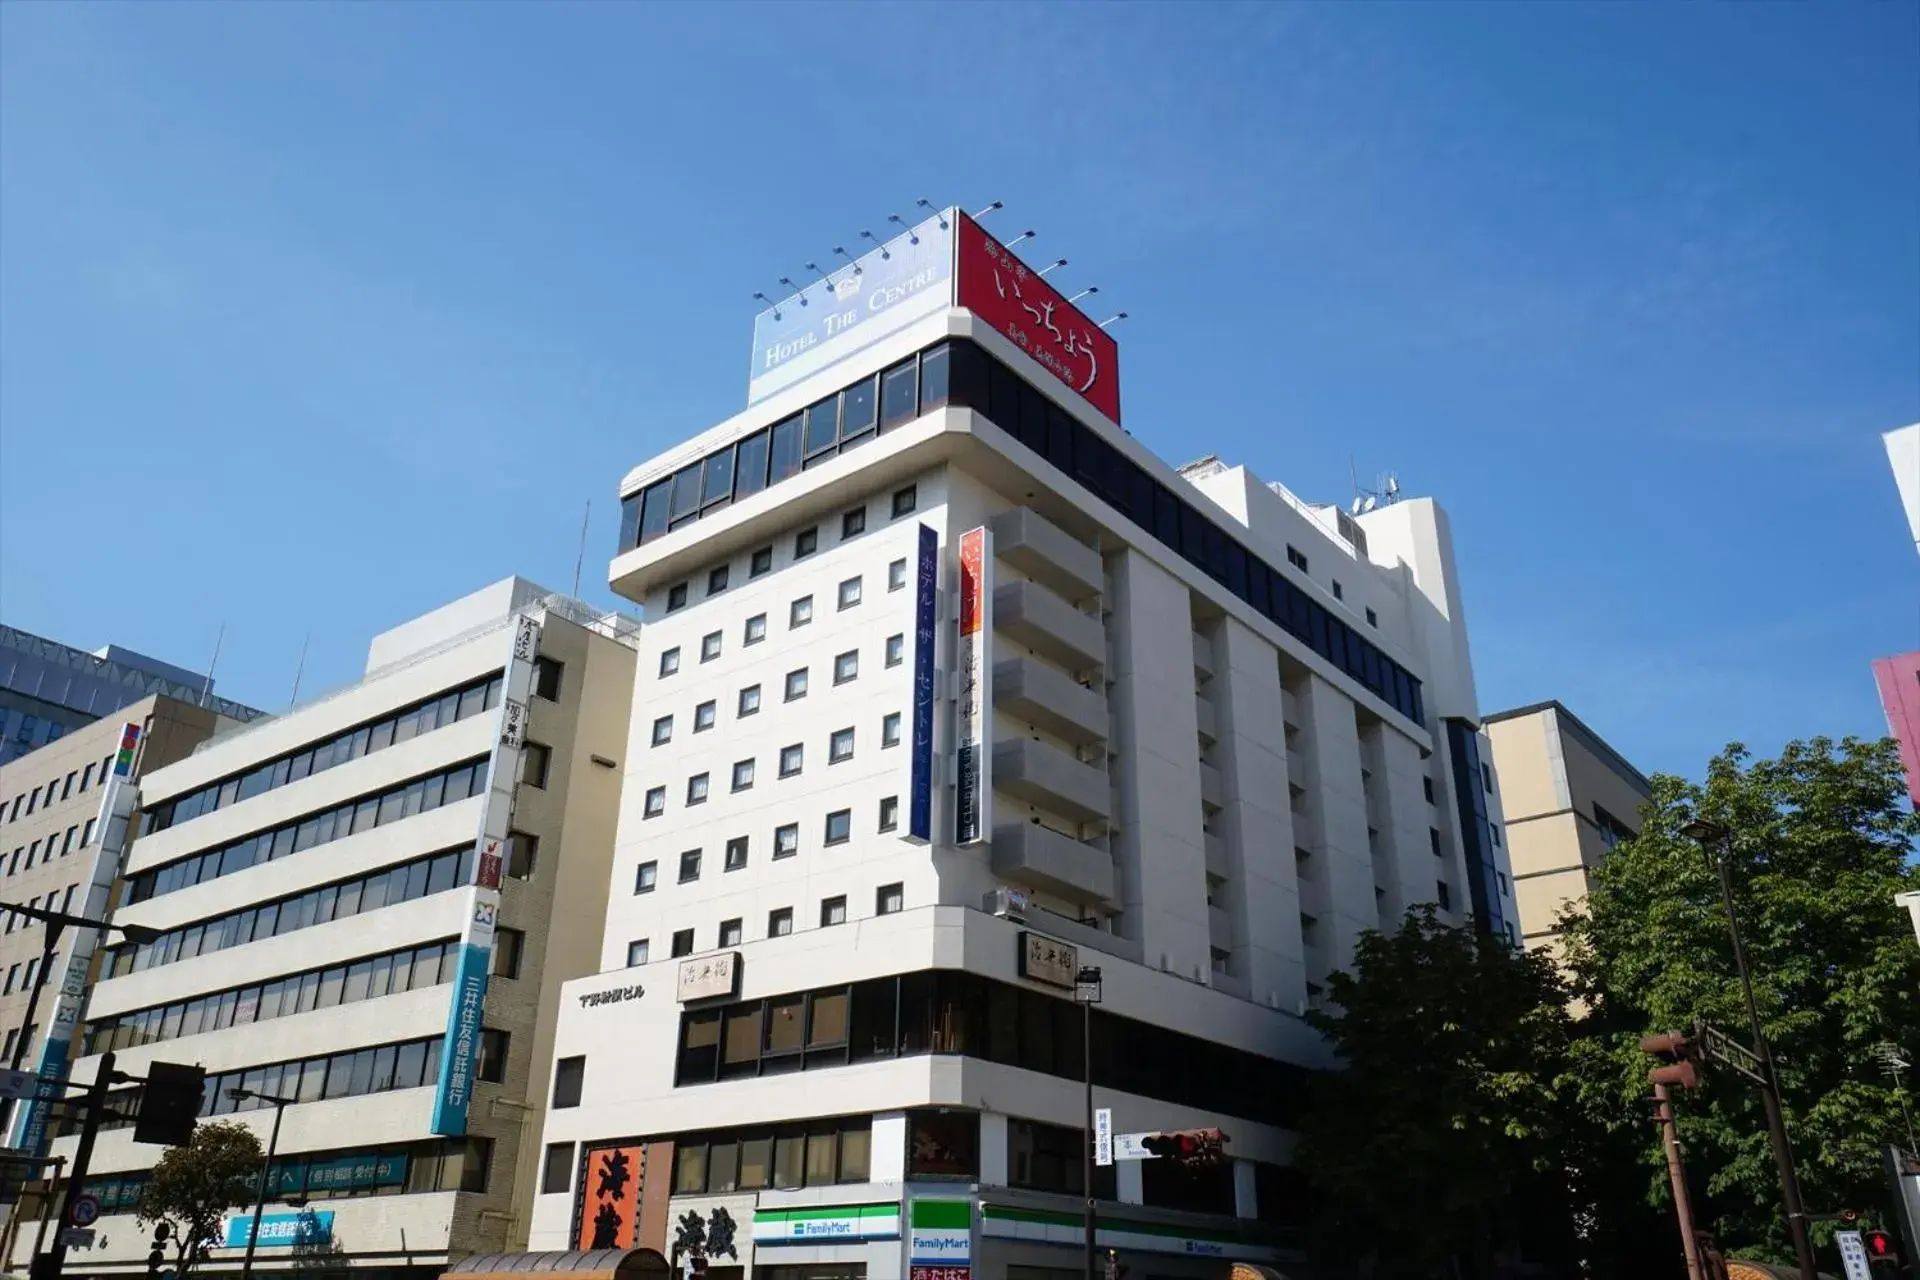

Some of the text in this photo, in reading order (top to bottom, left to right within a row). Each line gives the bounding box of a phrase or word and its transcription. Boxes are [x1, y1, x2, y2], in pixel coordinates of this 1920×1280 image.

[765, 332, 818, 368] HOTEL
[823, 308, 858, 336] THE
[994, 268, 1097, 393] いっちょう
[448, 975, 481, 1107] 三井住友信託銀行
[806, 1222, 851, 1235] FamilyMart
[913, 1237, 969, 1252] FamilyMart
